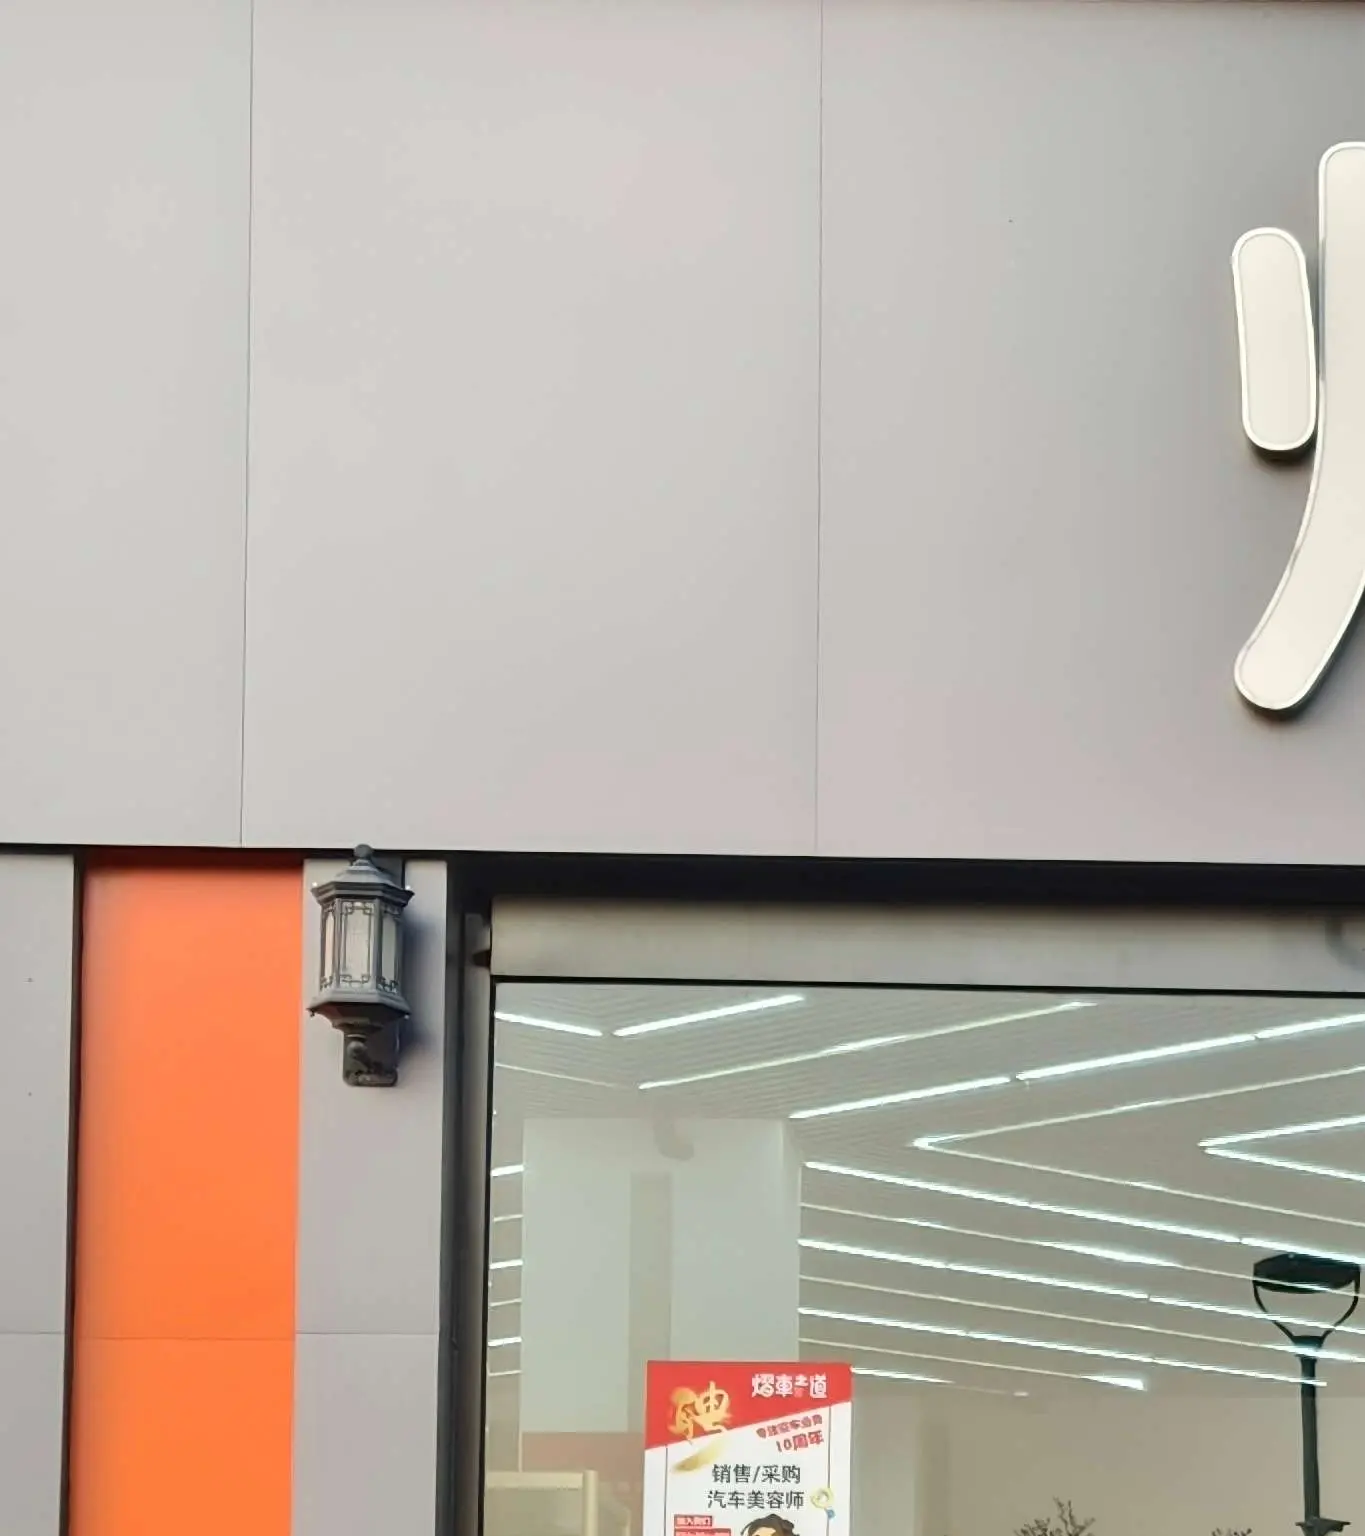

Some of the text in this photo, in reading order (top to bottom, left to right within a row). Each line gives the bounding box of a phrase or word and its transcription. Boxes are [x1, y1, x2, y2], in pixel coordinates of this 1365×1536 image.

[712, 1464, 801, 1484] 销售/采购
[707, 1490, 804, 1509] 汽车美容师
